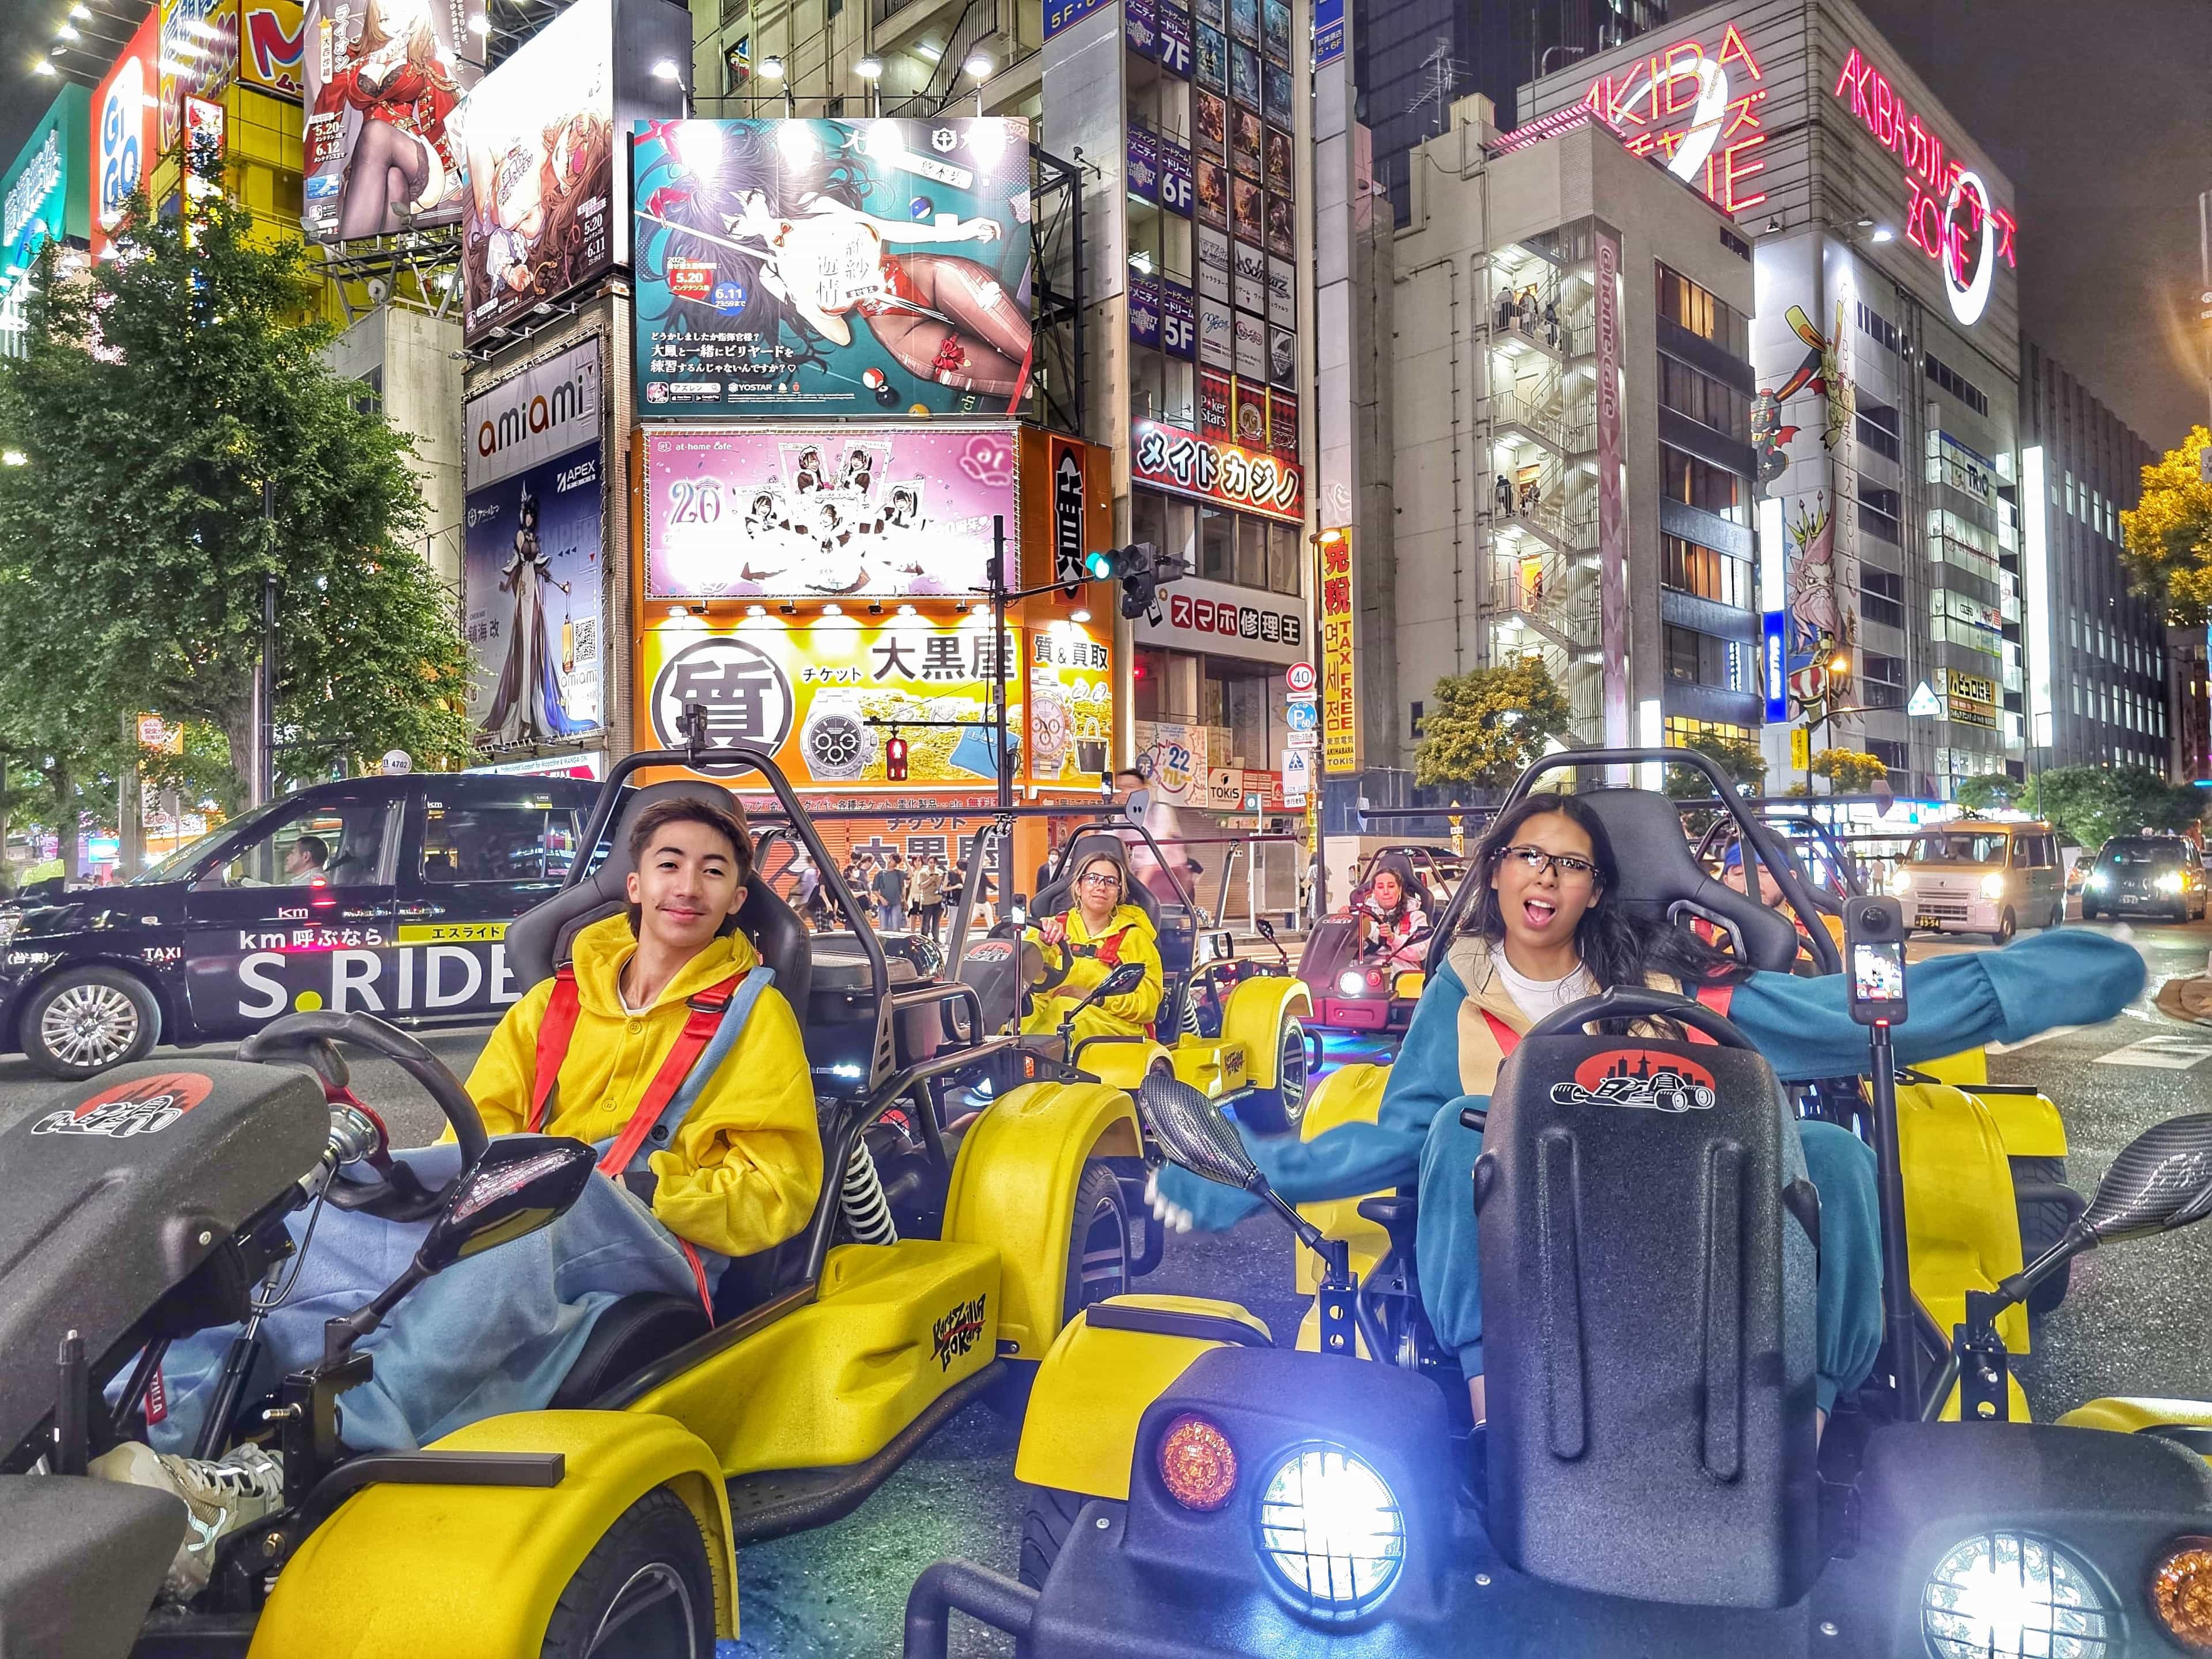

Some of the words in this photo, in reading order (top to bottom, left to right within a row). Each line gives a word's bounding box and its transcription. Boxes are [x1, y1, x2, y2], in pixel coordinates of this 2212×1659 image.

[334, 5, 350, 73] ライオン
[1161, 32, 1190, 70] 7F
[1127, 126, 1157, 145] レーディング
[316, 141, 340, 156] 6.12
[1163, 173, 1191, 208] 6F
[584, 213, 603, 236] 5.20
[587, 236, 605, 258] 6.11
[676, 272, 704, 283] 5.20
[1128, 274, 1158, 290] レーディング
[715, 289, 743, 299] 6.11
[1599, 244, 1615, 355] @home
[1165, 315, 1193, 350] 5F
[650, 344, 794, 358] 大鳳と一緒にビリヤードを
[1603, 356, 1615, 419] cafe
[478, 374, 584, 457] amiami
[1201, 408, 1227, 427] Stars
[567, 460, 596, 482] APEX
[1137, 429, 1300, 510] メイドカジノ
[671, 482, 721, 525] 20
[1324, 540, 1351, 617] 免税
[490, 618, 499, 639] 改
[1171, 594, 1301, 646] スマホ修理王
[1339, 620, 1352, 665] TAX
[873, 635, 1015, 681] 大黒屋
[561, 669, 597, 688] amiami
[803, 667, 862, 683] チケット
[1294, 671, 1309, 683] 40
[668, 658, 774, 753] 質
[1340, 672, 1353, 730] FREE
[1294, 709, 1305, 728] P
[1169, 746, 1190, 772] 22
[1327, 748, 1354, 757] AKIHABARA
[1327, 757, 1354, 766] TOKIS
[391, 760, 408, 768] 4702
[278, 907, 309, 918] km
[240, 930, 286, 950] km
[293, 928, 382, 949] 呼ぶなら
[432, 926, 500, 940] エスライド
[144, 947, 181, 960] TAXI
[238, 944, 523, 1019] S.RIDE
